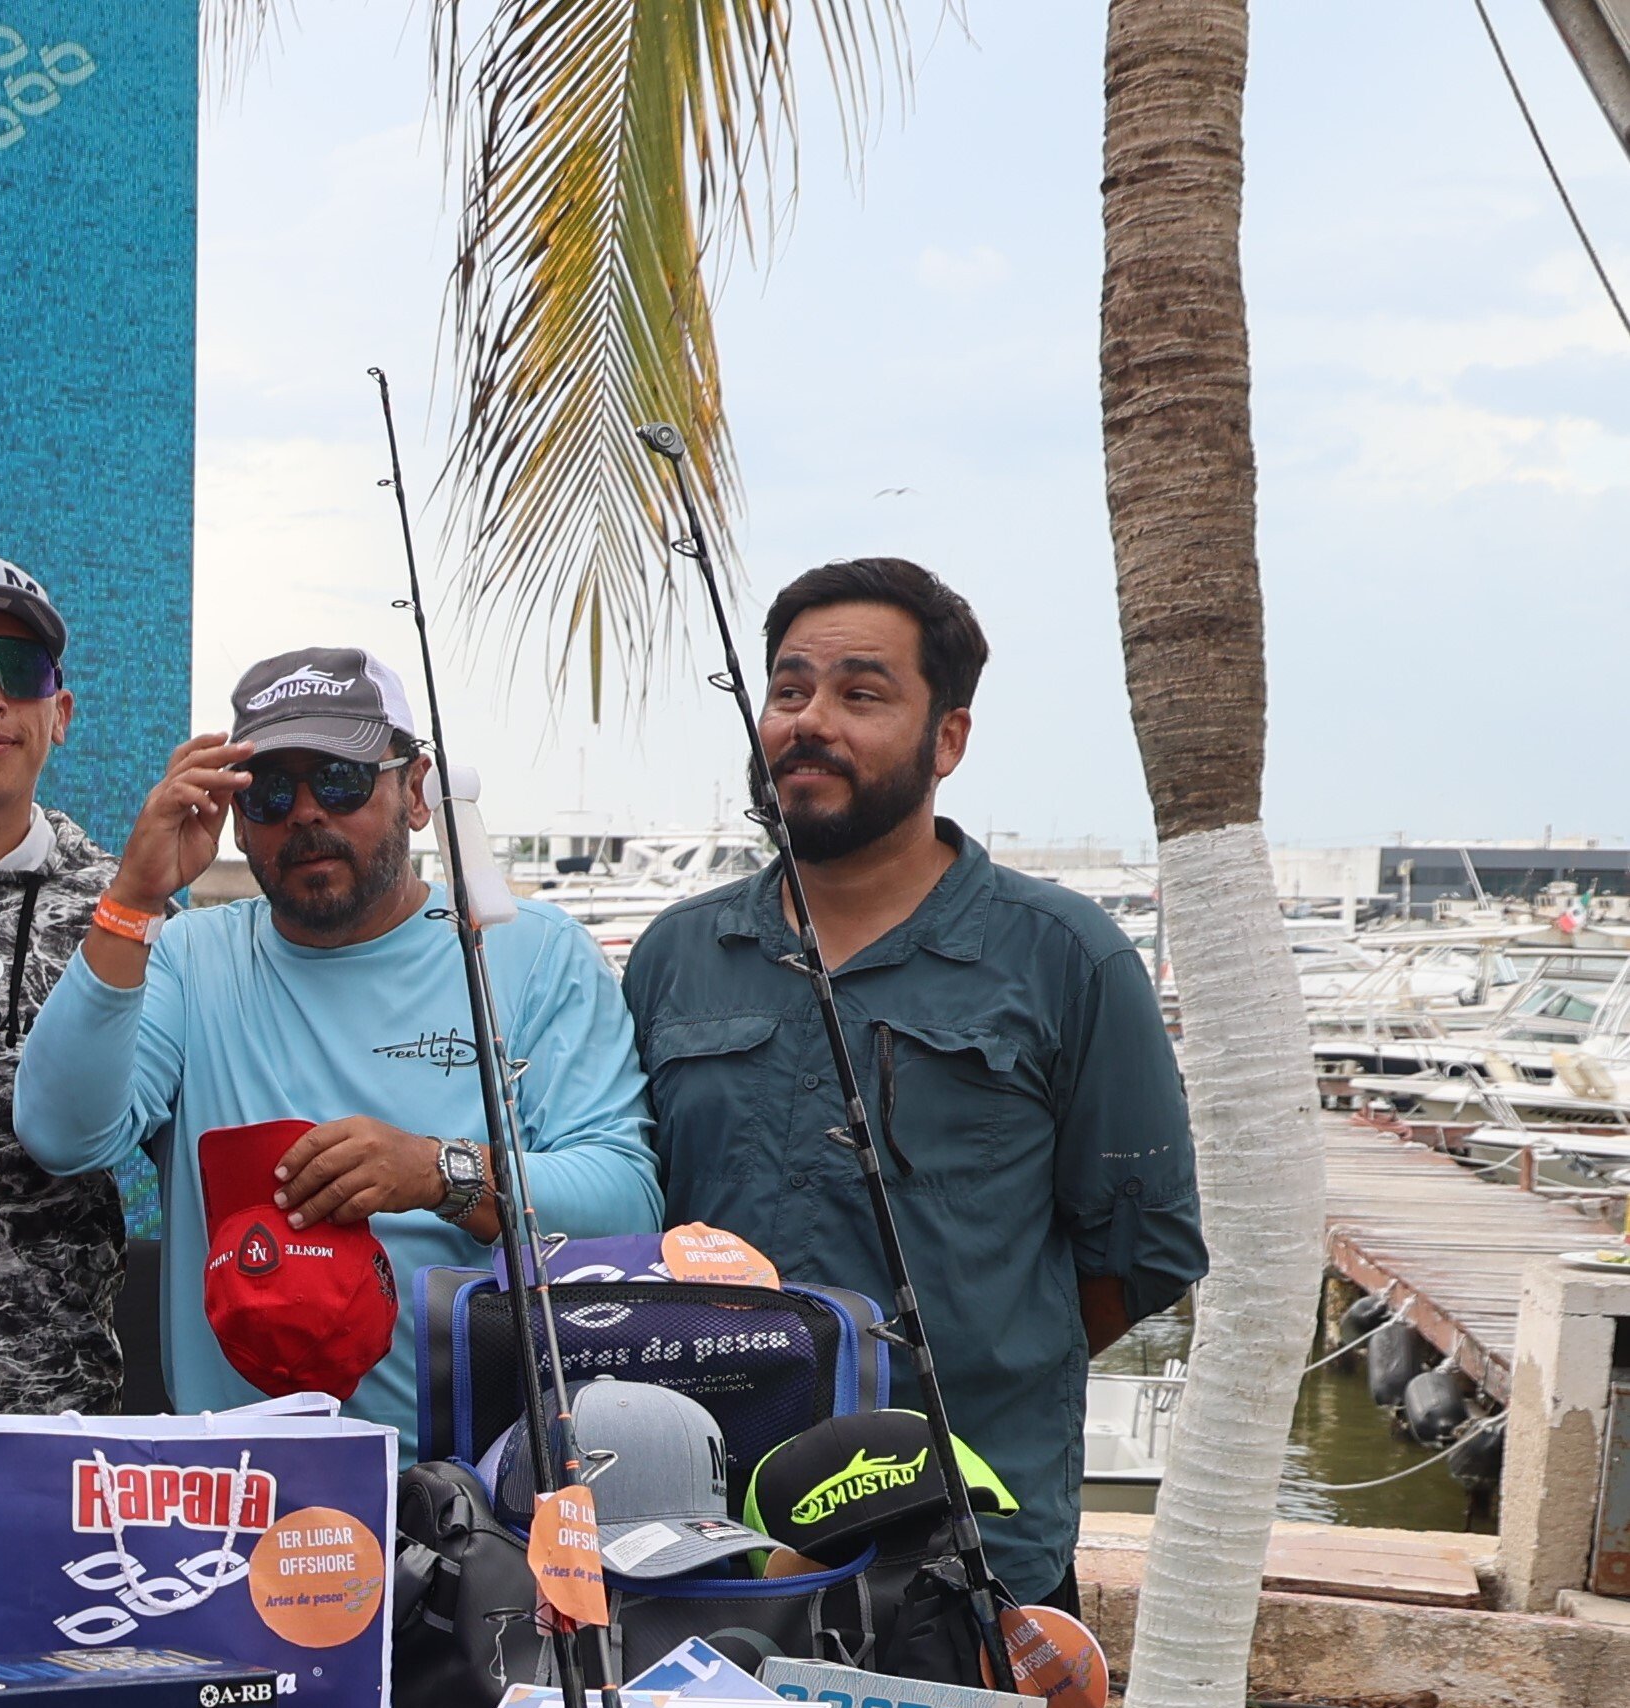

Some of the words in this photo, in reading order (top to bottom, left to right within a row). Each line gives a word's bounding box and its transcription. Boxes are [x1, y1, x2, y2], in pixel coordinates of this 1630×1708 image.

[273, 677, 344, 700] MUSTAD
[285, 1243, 335, 1259] MONTE
[699, 1232, 738, 1248] LUGAR
[685, 1249, 748, 1263] OFFSHORE
[827, 1466, 916, 1505] MUSTAD
[276, 1530, 305, 1549] 1ER
[307, 1527, 353, 1549] LUGAR
[278, 1552, 356, 1577] OFFSHORE
